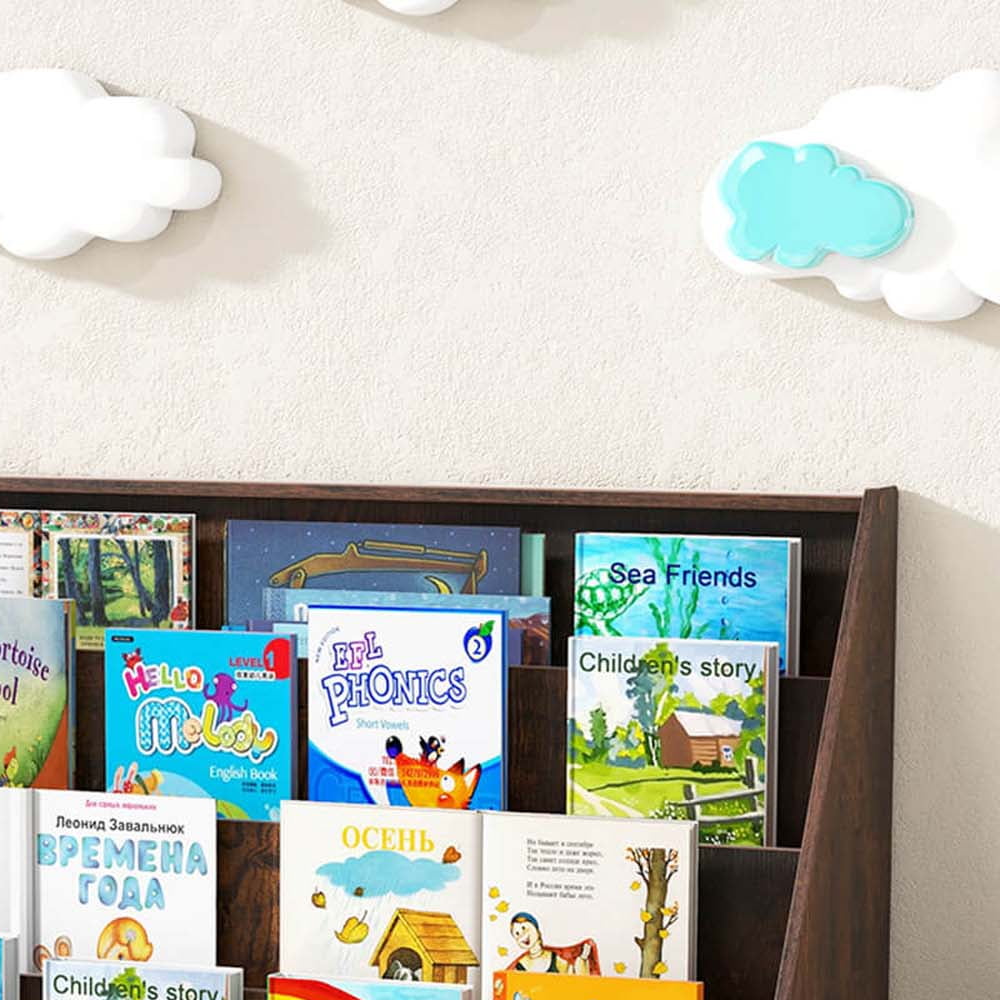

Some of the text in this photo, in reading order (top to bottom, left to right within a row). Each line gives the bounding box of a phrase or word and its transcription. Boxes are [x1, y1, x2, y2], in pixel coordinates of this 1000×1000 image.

[609, 562, 757, 588] Sea Friends
[333, 631, 383, 671] EFL
[473, 639, 482, 655] 2
[229, 656, 263, 668] LEVEL
[579, 652, 757, 684] Children's story
[124, 664, 203, 698] HELLO
[321, 664, 467, 727] PHONICS
[356, 719, 380, 730] Short
[209, 765, 278, 783] English Book
[56, 816, 185, 834] Леонид Завальнюк
[341, 825, 435, 853] ОСЕНЬ
[37, 833, 208, 876] ВРЕМЕНА
[78, 873, 165, 911] ГОДА
